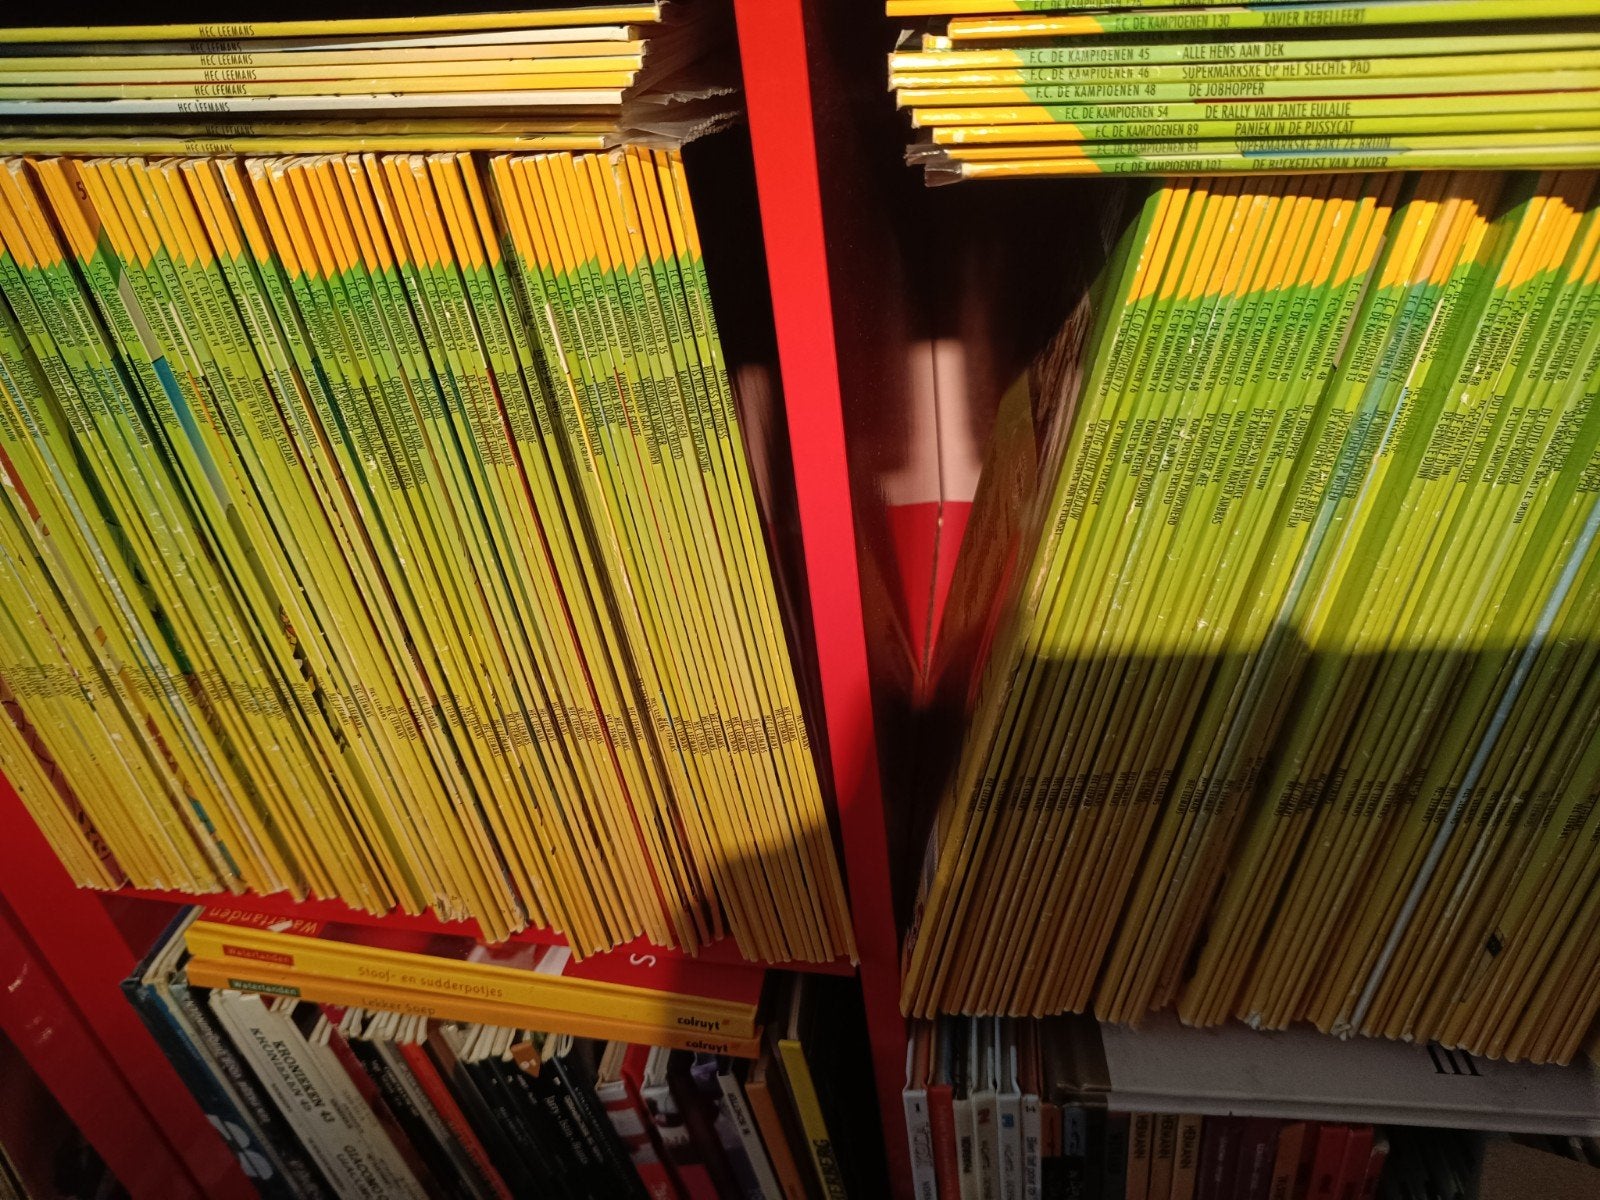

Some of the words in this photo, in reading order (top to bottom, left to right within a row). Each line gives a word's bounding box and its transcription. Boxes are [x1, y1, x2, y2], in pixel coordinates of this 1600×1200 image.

[1116, 18, 1130, 31] F.C.
[1133, 17, 1144, 30] DE
[1149, 15, 1208, 29] KAMPIOENEN
[1213, 14, 1230, 28] 130
[1262, 12, 1300, 26] XAVIER
[1303, 9, 1366, 25] REBELLEERT
[199, 26, 216, 37] HEC
[218, 25, 254, 36] LEEMANS
[201, 55, 216, 66] HEC
[218, 55, 252, 65] LEEMANS
[1030, 52, 1047, 63] F.C.
[1052, 52, 1064, 62] DE
[1068, 49, 1134, 62] KAMPIOENEN
[1138, 48, 1150, 60] 45
[1183, 46, 1206, 60] ALLE
[1210, 45, 1236, 58] HENS
[1239, 44, 1260, 58] AAN
[1265, 44, 1284, 57] DEK
[204, 71, 220, 81] HEC
[222, 70, 256, 80] LEEMANS
[1031, 70, 1047, 81] F.C.
[1052, 70, 1064, 80] DE
[1069, 68, 1133, 80] KAMPIOENEN
[1138, 67, 1150, 78] 46
[1182, 65, 1261, 79] SUPERMARKSKE
[1265, 64, 1279, 77] OP
[1283, 64, 1300, 76] HET
[1304, 62, 1346, 76] SLECHTE
[1350, 61, 1371, 74] PAD
[194, 85, 209, 95] HEC
[212, 84, 247, 95] LEEMANS
[1036, 88, 1052, 98] F.C.
[1058, 86, 1070, 97] DE
[1074, 84, 1140, 97] KAMPIOENEN
[1144, 84, 1156, 96] 48
[1189, 83, 1202, 96] DE
[1205, 82, 1264, 96] JOBHOPPER
[1065, 108, 1079, 120] F.C.
[1082, 107, 1093, 119] DE
[1097, 106, 1154, 119] KAMPIOENEN
[1158, 106, 1168, 118] 54
[1206, 105, 1218, 119] DE
[1222, 104, 1250, 118] RALLY
[1254, 104, 1274, 117] VAN
[1278, 103, 1307, 117] TANTE
[1311, 102, 1351, 117] EULALIE
[1096, 127, 1109, 138] F.C.
[1113, 126, 1124, 137] DE
[1127, 124, 1184, 137] KAMPIOENEN
[1187, 124, 1199, 136] 89
[1235, 122, 1270, 136] PANIEK
[1274, 122, 1284, 134] IN
[1289, 122, 1302, 134] DE
[1306, 120, 1354, 134] PUSSYCAT
[158, 257, 171, 271] F.C.
[164, 272, 176, 284] DE
[207, 272, 220, 286] F.C.
[639, 267, 650, 279] F.C.
[681, 267, 692, 277] F.C.
[643, 282, 653, 293] DE
[684, 279, 694, 288] DE
[1348, 281, 1361, 298] F.C.
[214, 288, 225, 298] DE
[170, 284, 197, 330] KAMPIOENEN
[1292, 296, 1305, 309] F.C.
[1342, 300, 1354, 312] DE
[1487, 296, 1501, 311] F.C.
[1576, 294, 1589, 308] F.C.
[686, 290, 704, 330] KAMPIOENEN
[1287, 309, 1300, 322] DE
[1482, 311, 1495, 324] DE
[1569, 308, 1582, 322] DE
[219, 300, 245, 345] KAMPIOENEN
[646, 295, 665, 343] KAMPIOENEN
[191, 332, 201, 341] 15
[1322, 314, 1347, 368] KAMPIOENEN
[658, 345, 668, 354] 35
[1271, 322, 1294, 370] KAMPIOENEN
[1463, 323, 1489, 373] KAMPIOENEN
[1549, 320, 1576, 371] KAMPIOENEN
[202, 360, 214, 371] DE
[702, 365, 718, 399] BUZINESS
[1265, 370, 1277, 381] 61
[1315, 370, 1327, 381] 48
[1457, 372, 1470, 385] 88
[1542, 371, 1555, 383] 86
[207, 371, 229, 404] HUILENDE
[665, 375, 678, 398] AGENT
[251, 377, 274, 414] KAMPIOEN
[1250, 407, 1264, 420] DE
[1301, 403, 1314, 416] DE
[1439, 410, 1453, 424] DE
[1523, 407, 1537, 420] DE
[222, 403, 244, 437] HOOLIGAN
[267, 413, 281, 429] ZIJN
[670, 399, 688, 438] VERTONGEN
[712, 407, 728, 439] BUZINESS
[273, 429, 284, 437] IS
[1285, 416, 1307, 460] JOBHOPPER
[1426, 422, 1447, 455] GENIALE
[1232, 419, 1258, 469] KAMPIOENEN
[277, 437, 297, 467] PLEZANT!
[1497, 420, 1530, 487] LOTTO-KAMPIOEN
[1416, 454, 1435, 481] DJINN
[1221, 469, 1240, 496] MAKEN
[1212, 496, 1228, 524] AMBRAS
[359, 966, 396, 982] Stoof-
[402, 975, 416, 984] en
[421, 977, 503, 997] sudderpotjes
[678, 1016, 720, 1031] colruyt
[686, 1040, 729, 1052] colruyt
